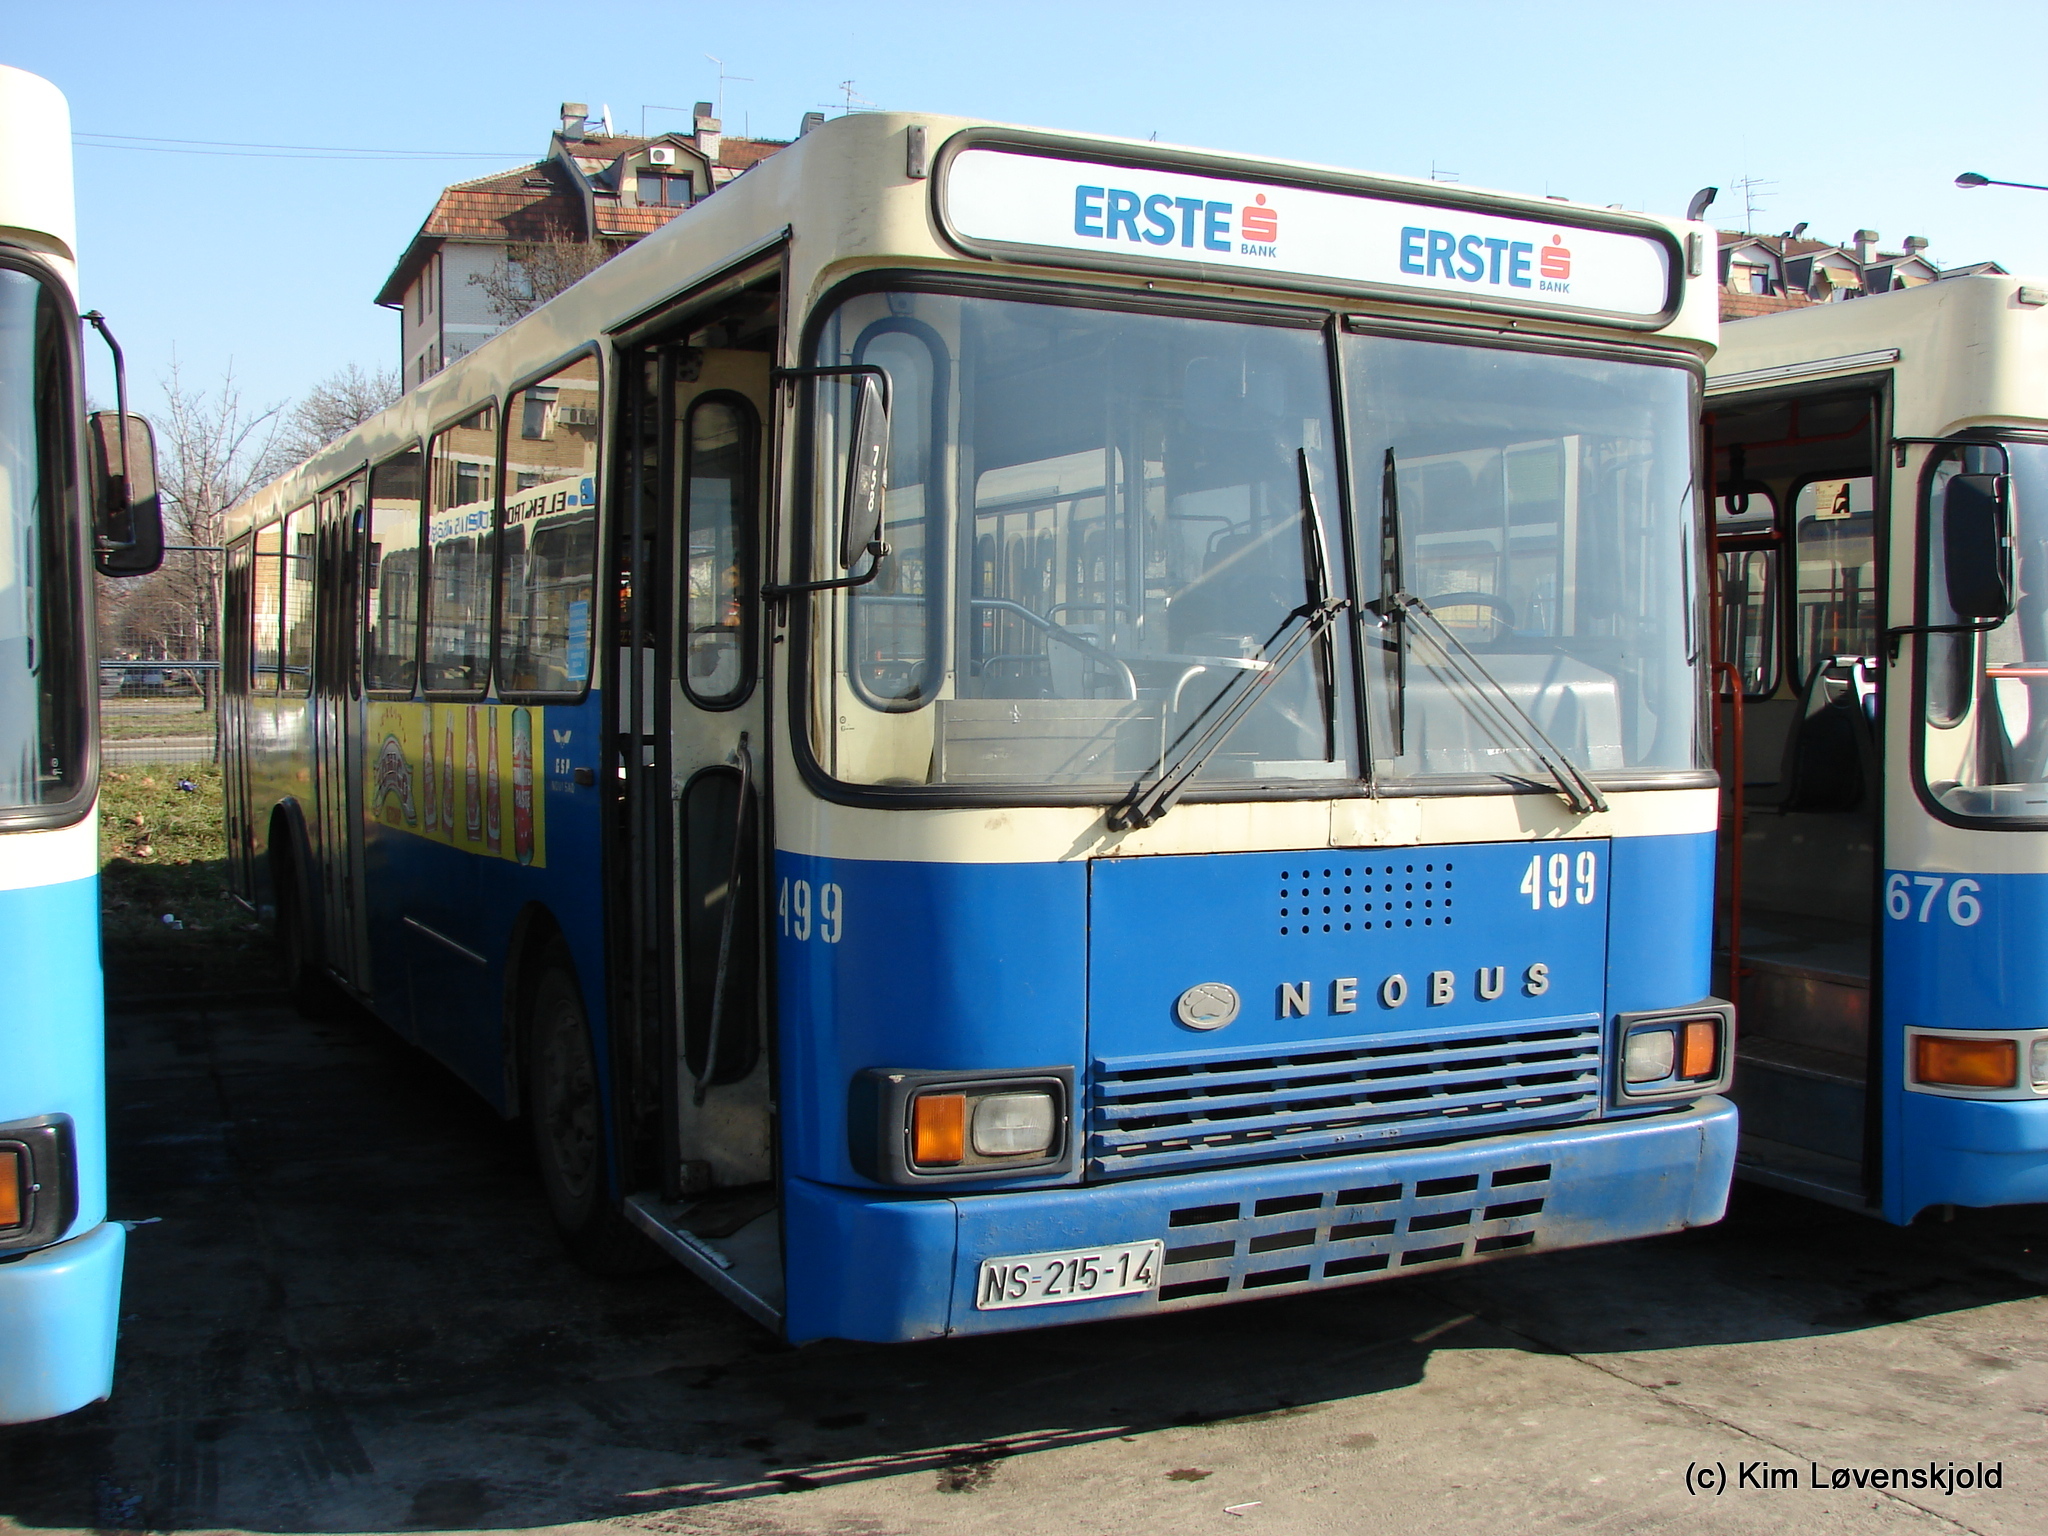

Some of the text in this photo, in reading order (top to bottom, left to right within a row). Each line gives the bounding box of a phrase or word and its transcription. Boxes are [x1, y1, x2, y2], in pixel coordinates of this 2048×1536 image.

[1074, 185, 1233, 252] ERSTE
[1240, 243, 1277, 258] BANK
[1399, 226, 1533, 289] ERSTE
[1539, 280, 1571, 294] BANK
[868, 445, 880, 512] 758
[779, 876, 843, 943] 499
[1520, 851, 1596, 910] 499
[1885, 873, 1981, 927] 676
[1281, 962, 1549, 1018] NEOBUS
